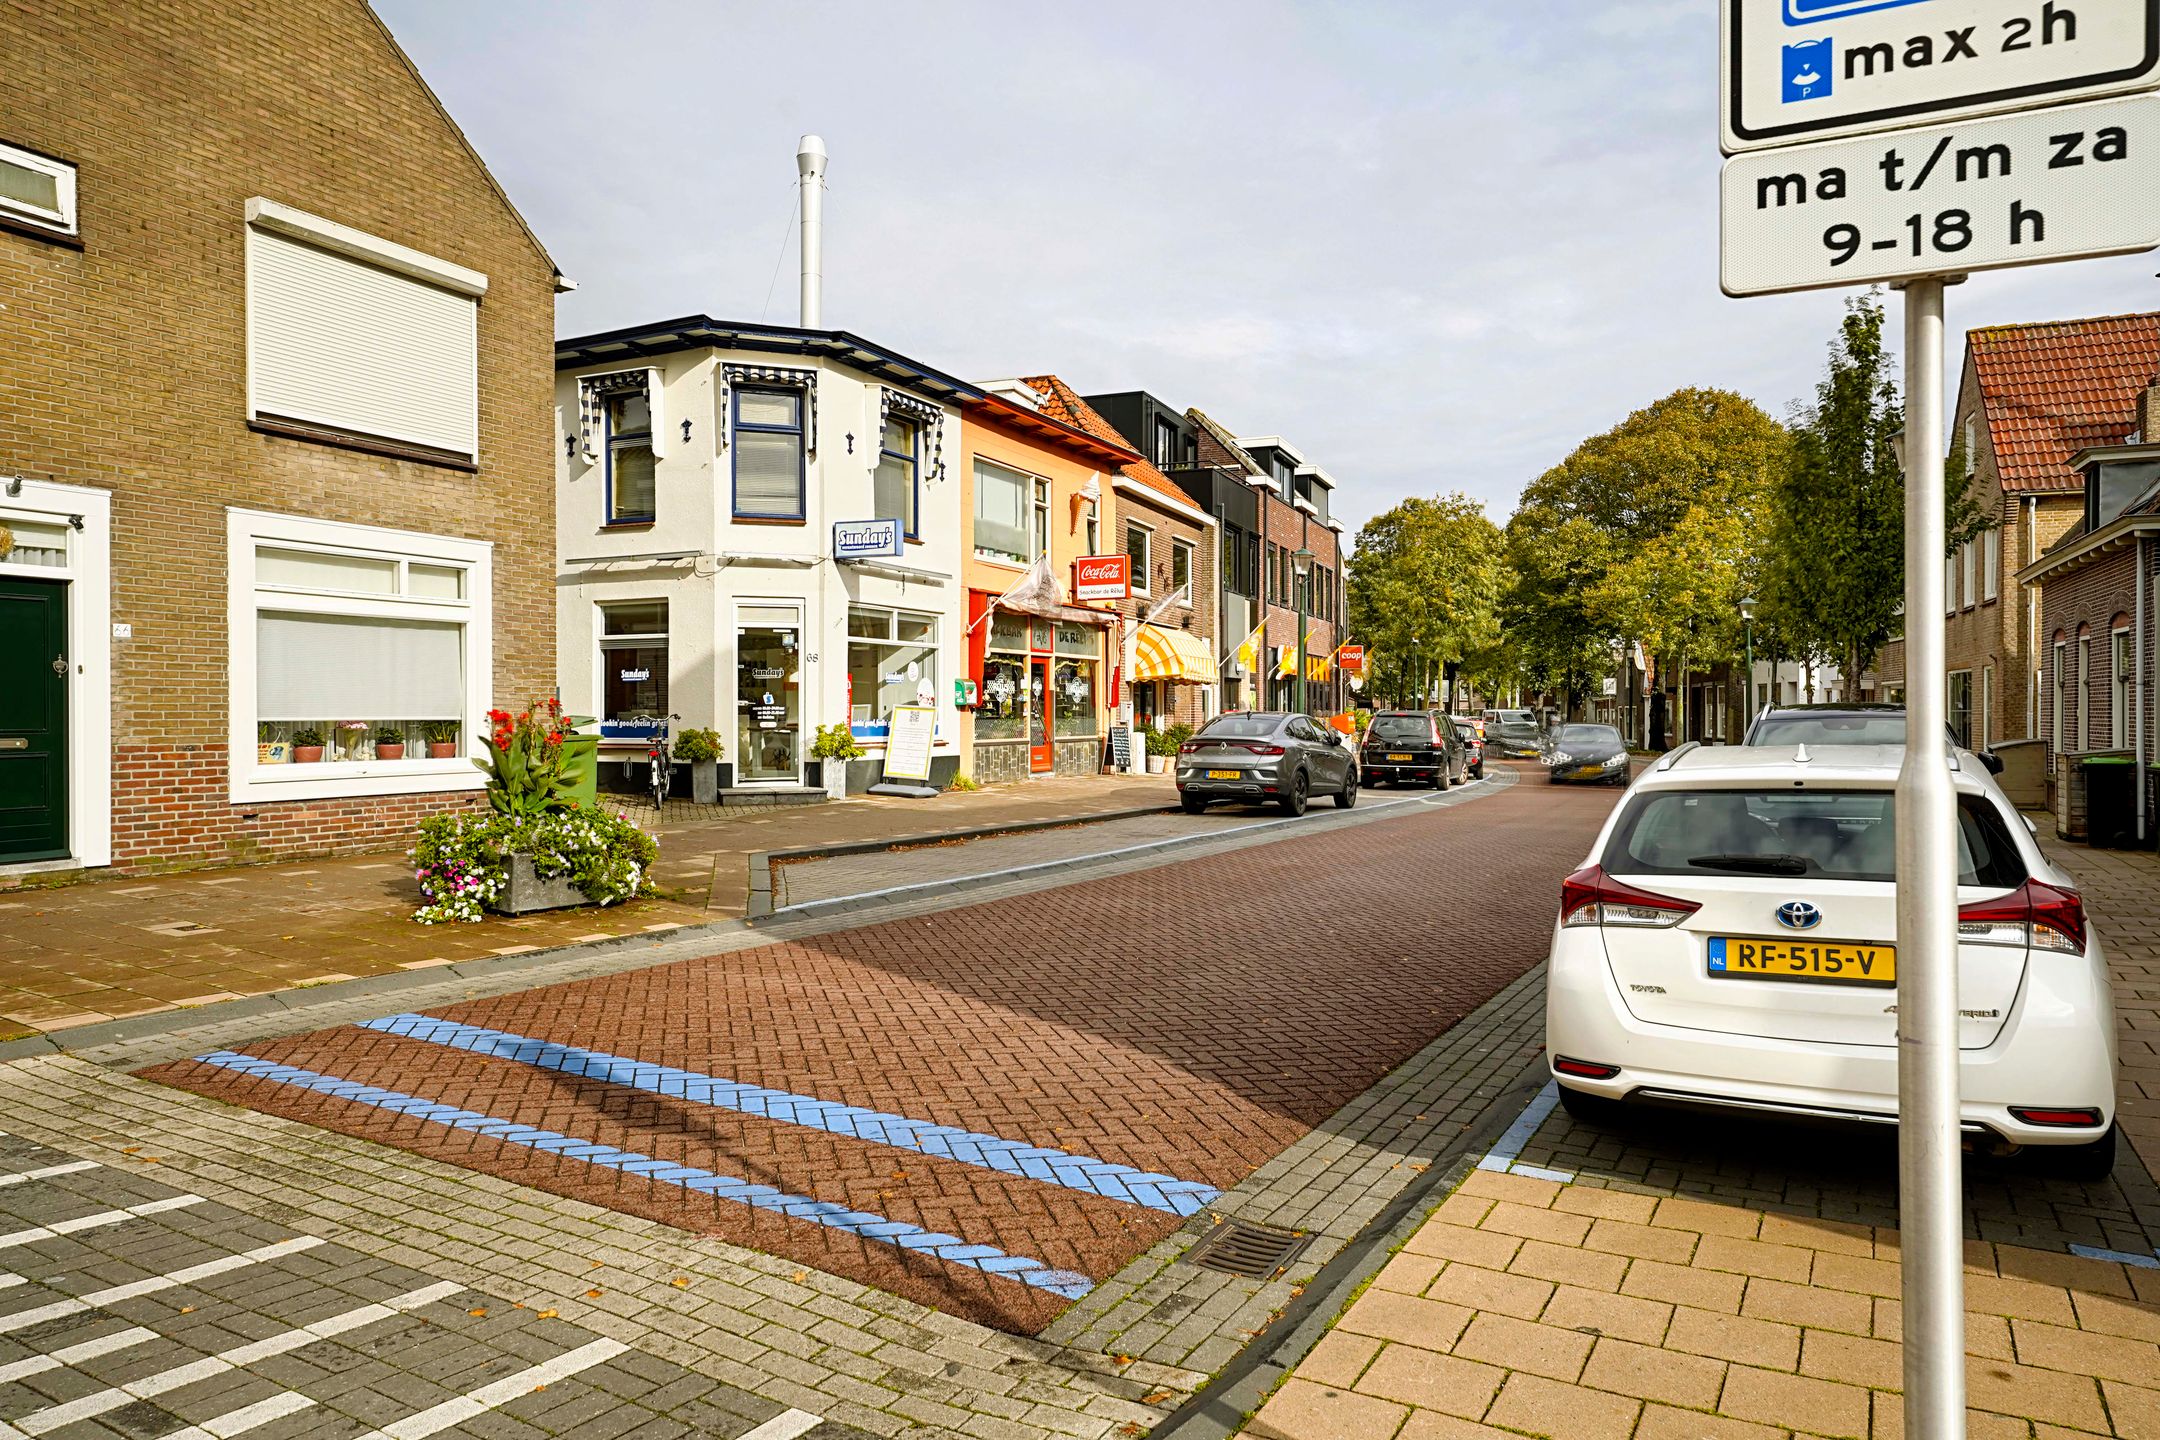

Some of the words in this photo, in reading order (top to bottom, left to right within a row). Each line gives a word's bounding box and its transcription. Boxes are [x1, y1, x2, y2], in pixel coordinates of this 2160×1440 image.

[1844, 26, 1979, 80] max
[2001, 1, 2077, 53] 2h
[1802, 86, 1812, 98] P
[1757, 166, 1846, 210] ma
[1879, 135, 2011, 191] t/m
[2048, 126, 2127, 169] za
[1822, 208, 1973, 267] 9-18
[2009, 200, 2045, 245] h
[838, 526, 893, 548] Sunday's
[1080, 563, 1122, 580] Coca-Cola
[114, 624, 130, 636] 66
[806, 652, 819, 663] 68
[1341, 652, 1361, 661] coop
[620, 667, 650, 681] Sunday's
[752, 666, 785, 679] Sunday's
[1712, 957, 1725, 966] NL
[1738, 943, 1876, 975] RF-515-V
[1629, 983, 1667, 994] TOYOTA
